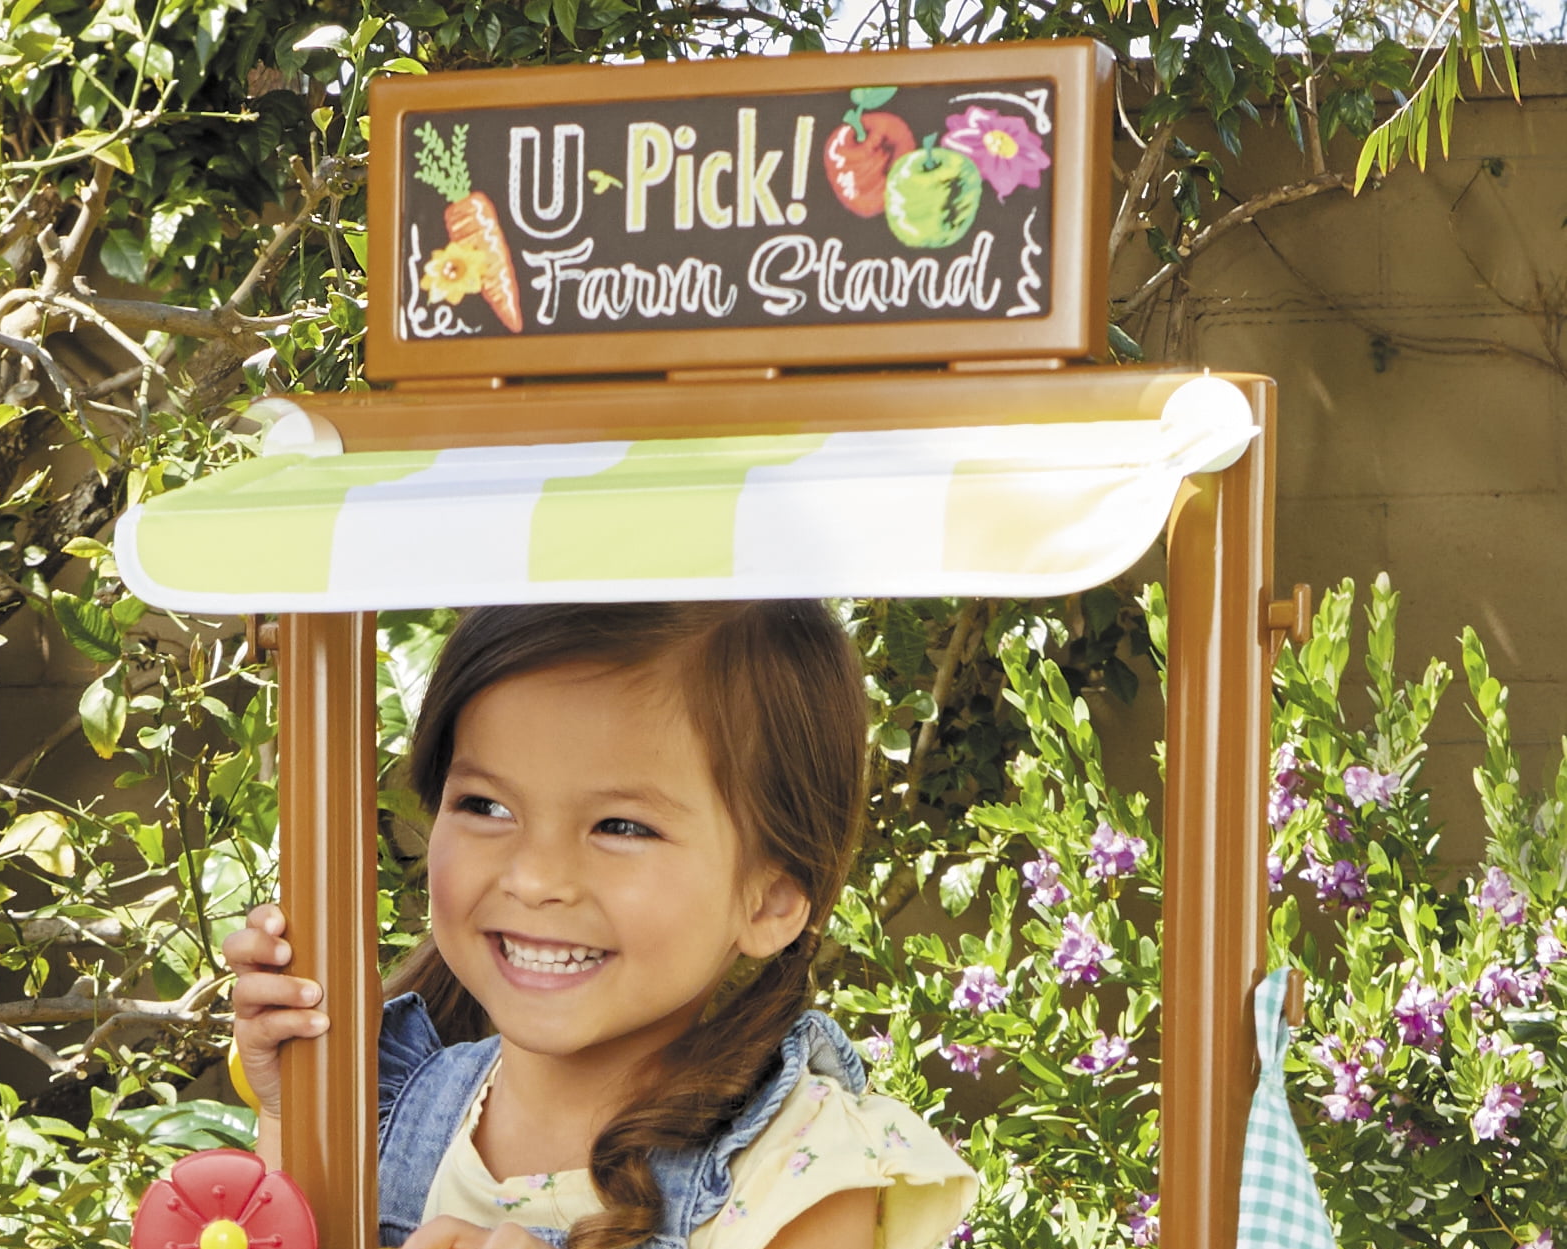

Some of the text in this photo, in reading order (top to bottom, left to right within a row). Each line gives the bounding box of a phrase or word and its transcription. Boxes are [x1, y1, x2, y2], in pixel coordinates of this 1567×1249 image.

[626, 109, 815, 232] Pick!
[523, 231, 1001, 324] Farm Stand
